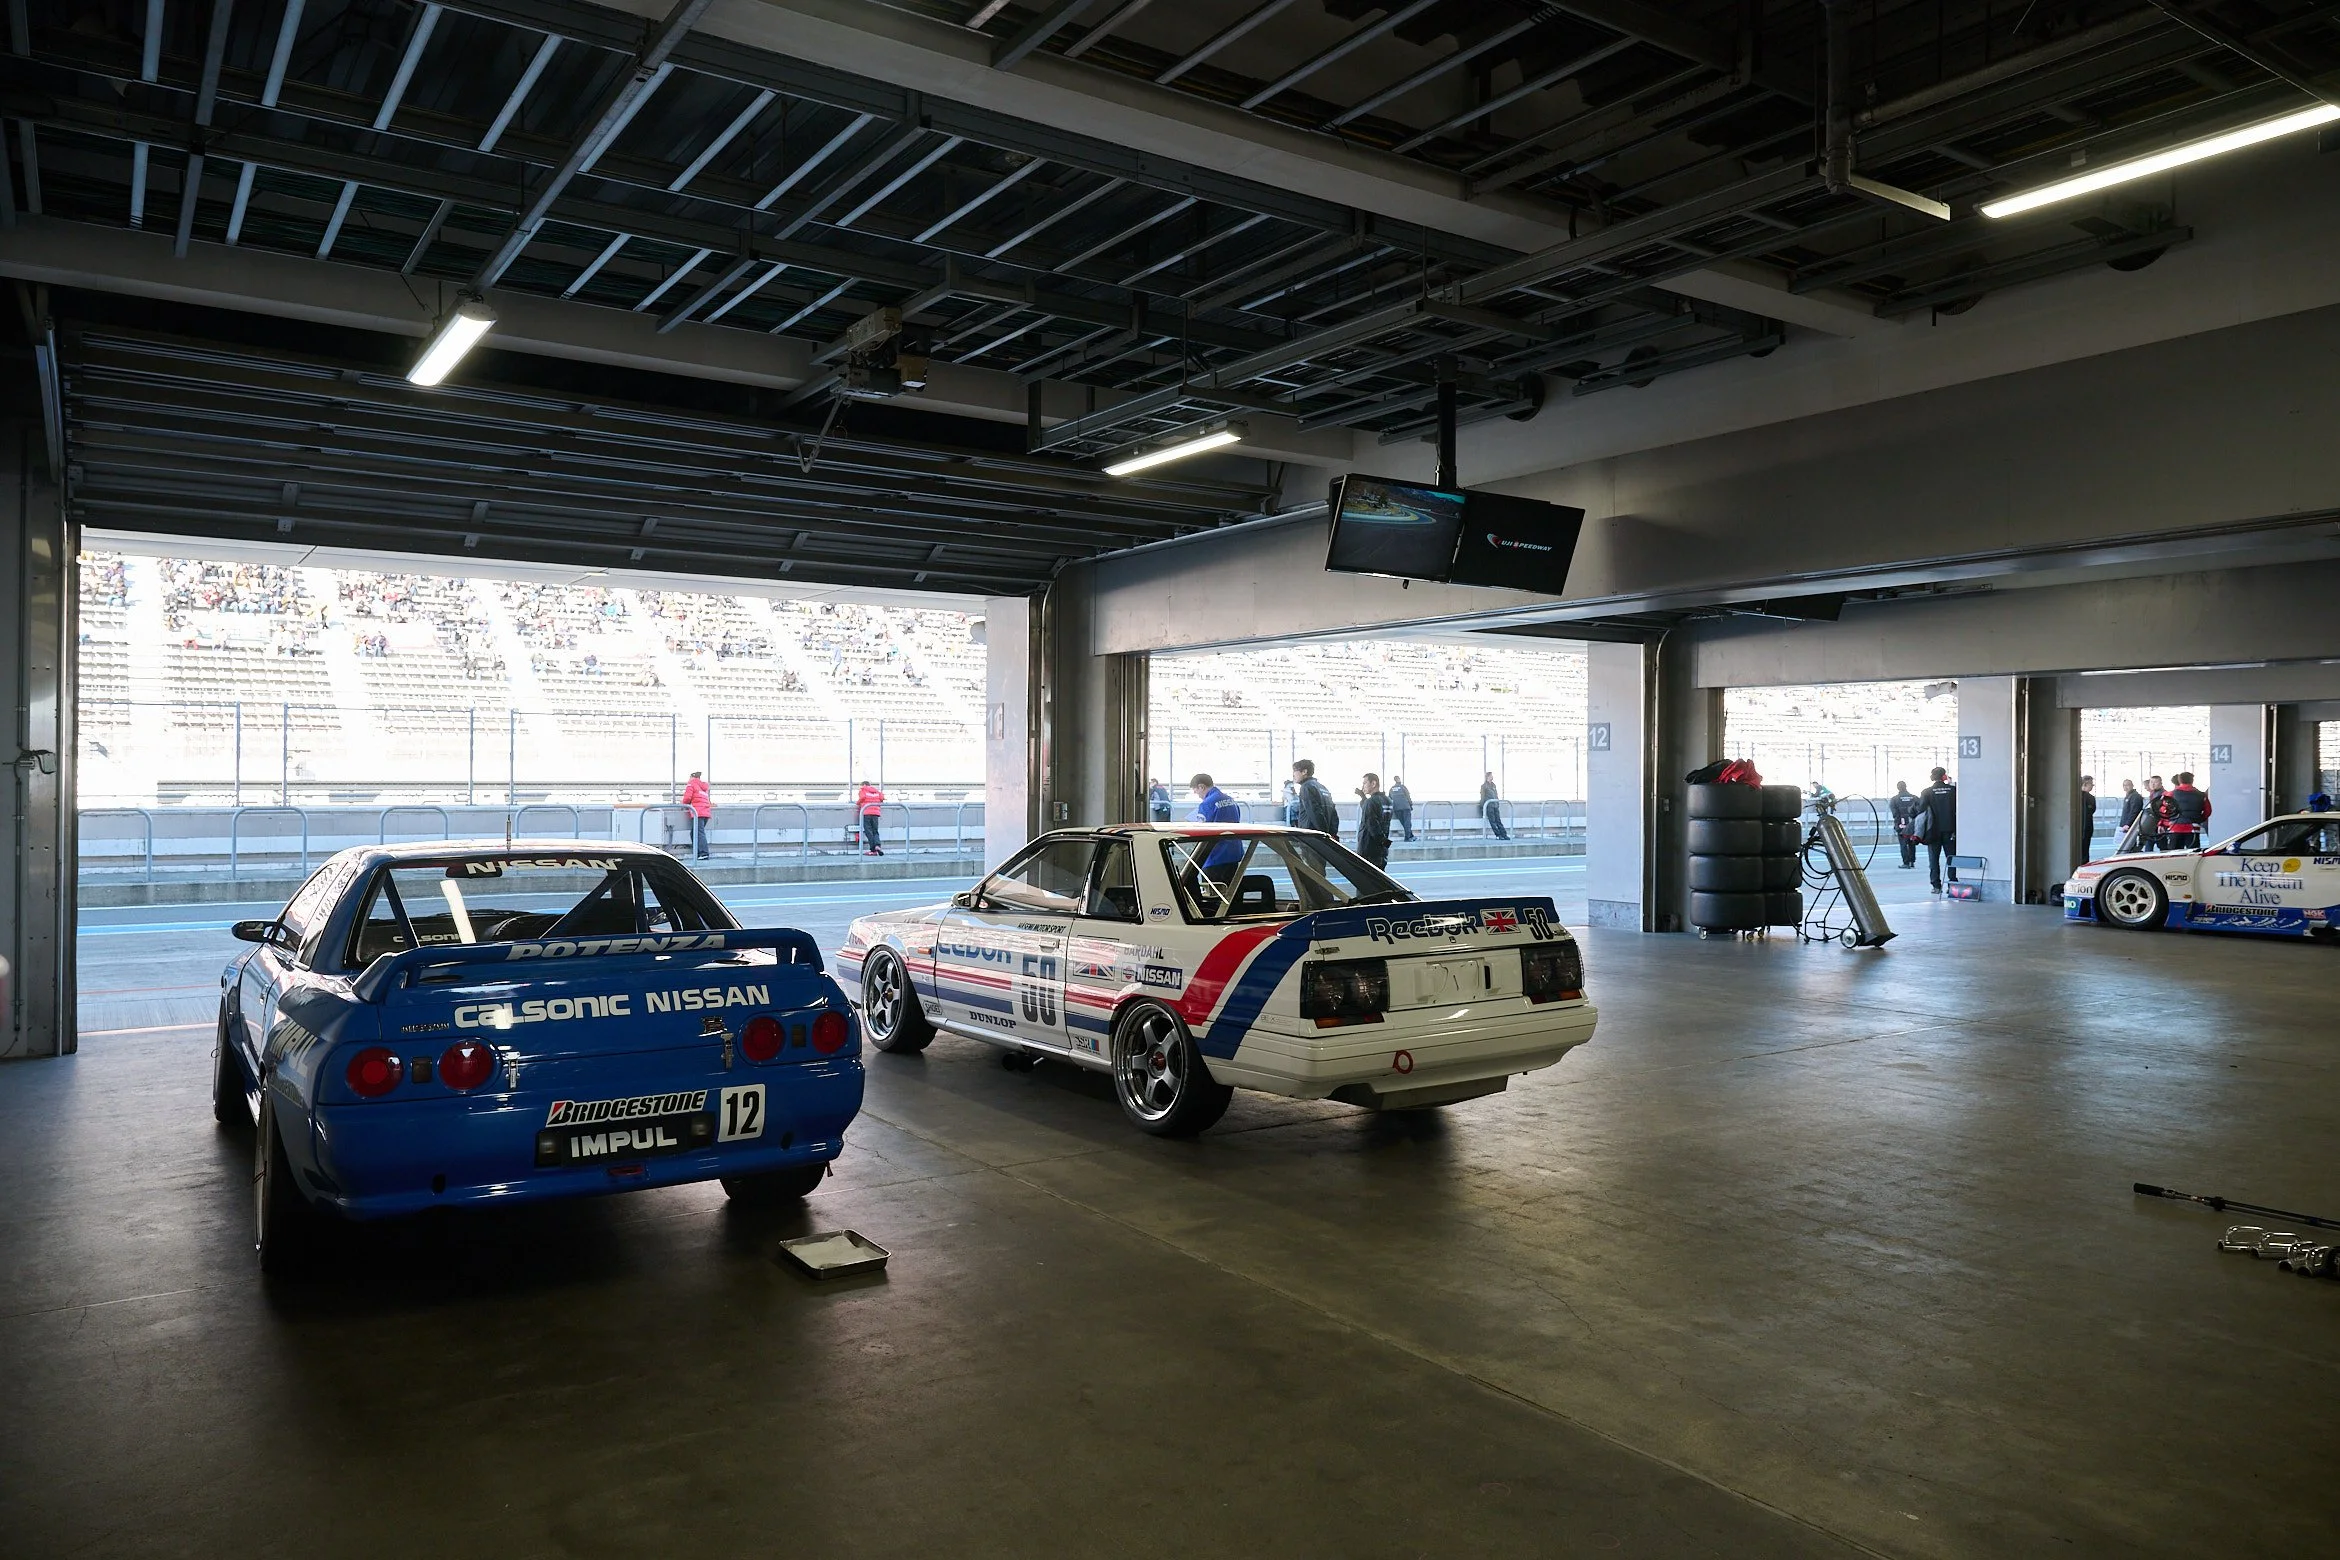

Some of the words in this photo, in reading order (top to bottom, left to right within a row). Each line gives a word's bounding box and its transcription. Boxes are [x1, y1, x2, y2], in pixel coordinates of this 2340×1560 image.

[1589, 726, 1608, 747] 12
[1960, 739, 1978, 756] 13
[2212, 747, 2230, 761] 14
[465, 858, 619, 875] NISSAN
[2240, 858, 2280, 873] Keep
[2313, 857, 2340, 865] NISM
[2239, 889, 2281, 905] Alive
[2206, 904, 2278, 917] BRIDGESTONE
[1522, 907, 1555, 941] 50
[505, 934, 725, 961] POTENZA
[1137, 967, 1181, 987] NISSAN
[646, 984, 771, 1014] NISSAN
[1021, 953, 1057, 1027] 50
[968, 1010, 1017, 1029] DUNLOP
[547, 1090, 708, 1127] BRIDGESTONE
[726, 1090, 760, 1136] 12
[571, 1126, 678, 1158] IMPUL
